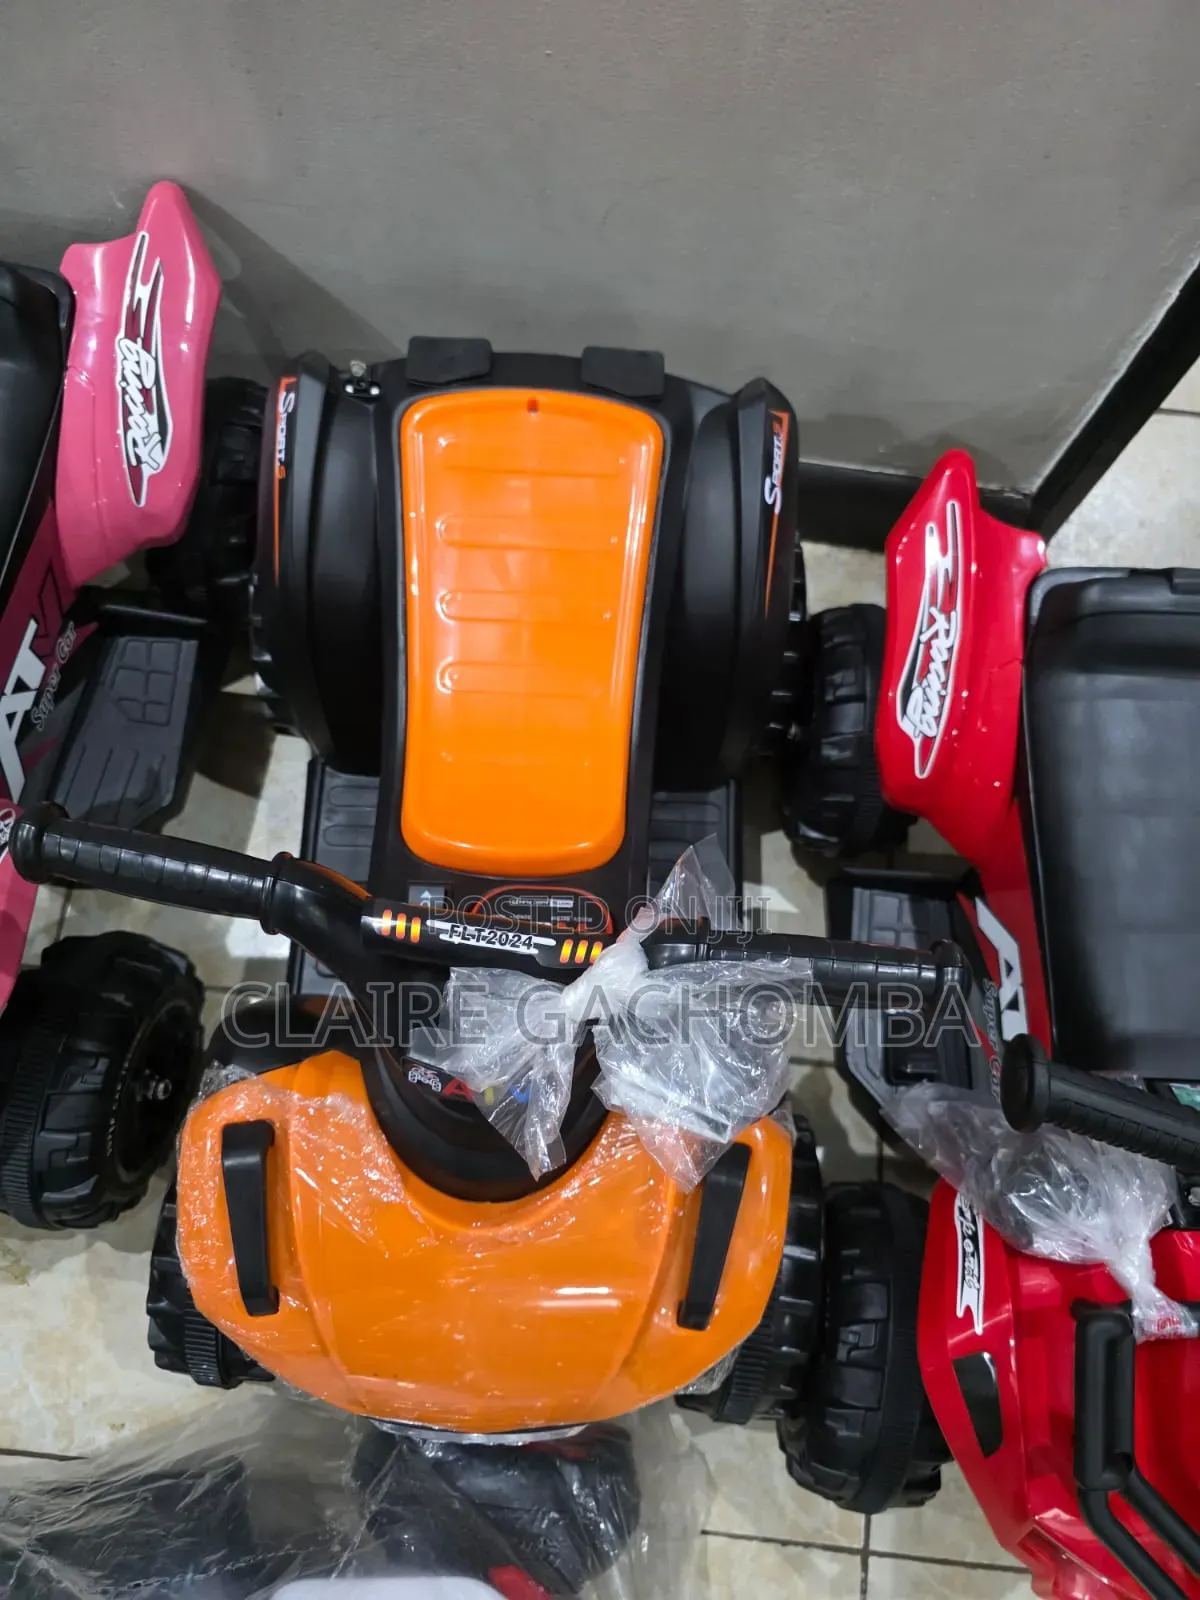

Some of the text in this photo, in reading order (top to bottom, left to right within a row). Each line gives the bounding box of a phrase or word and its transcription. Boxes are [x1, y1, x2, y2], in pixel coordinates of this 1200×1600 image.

[118, 336, 162, 472] Racing
[31, 620, 77, 732] Super Car
[906, 606, 956, 739] Racing
